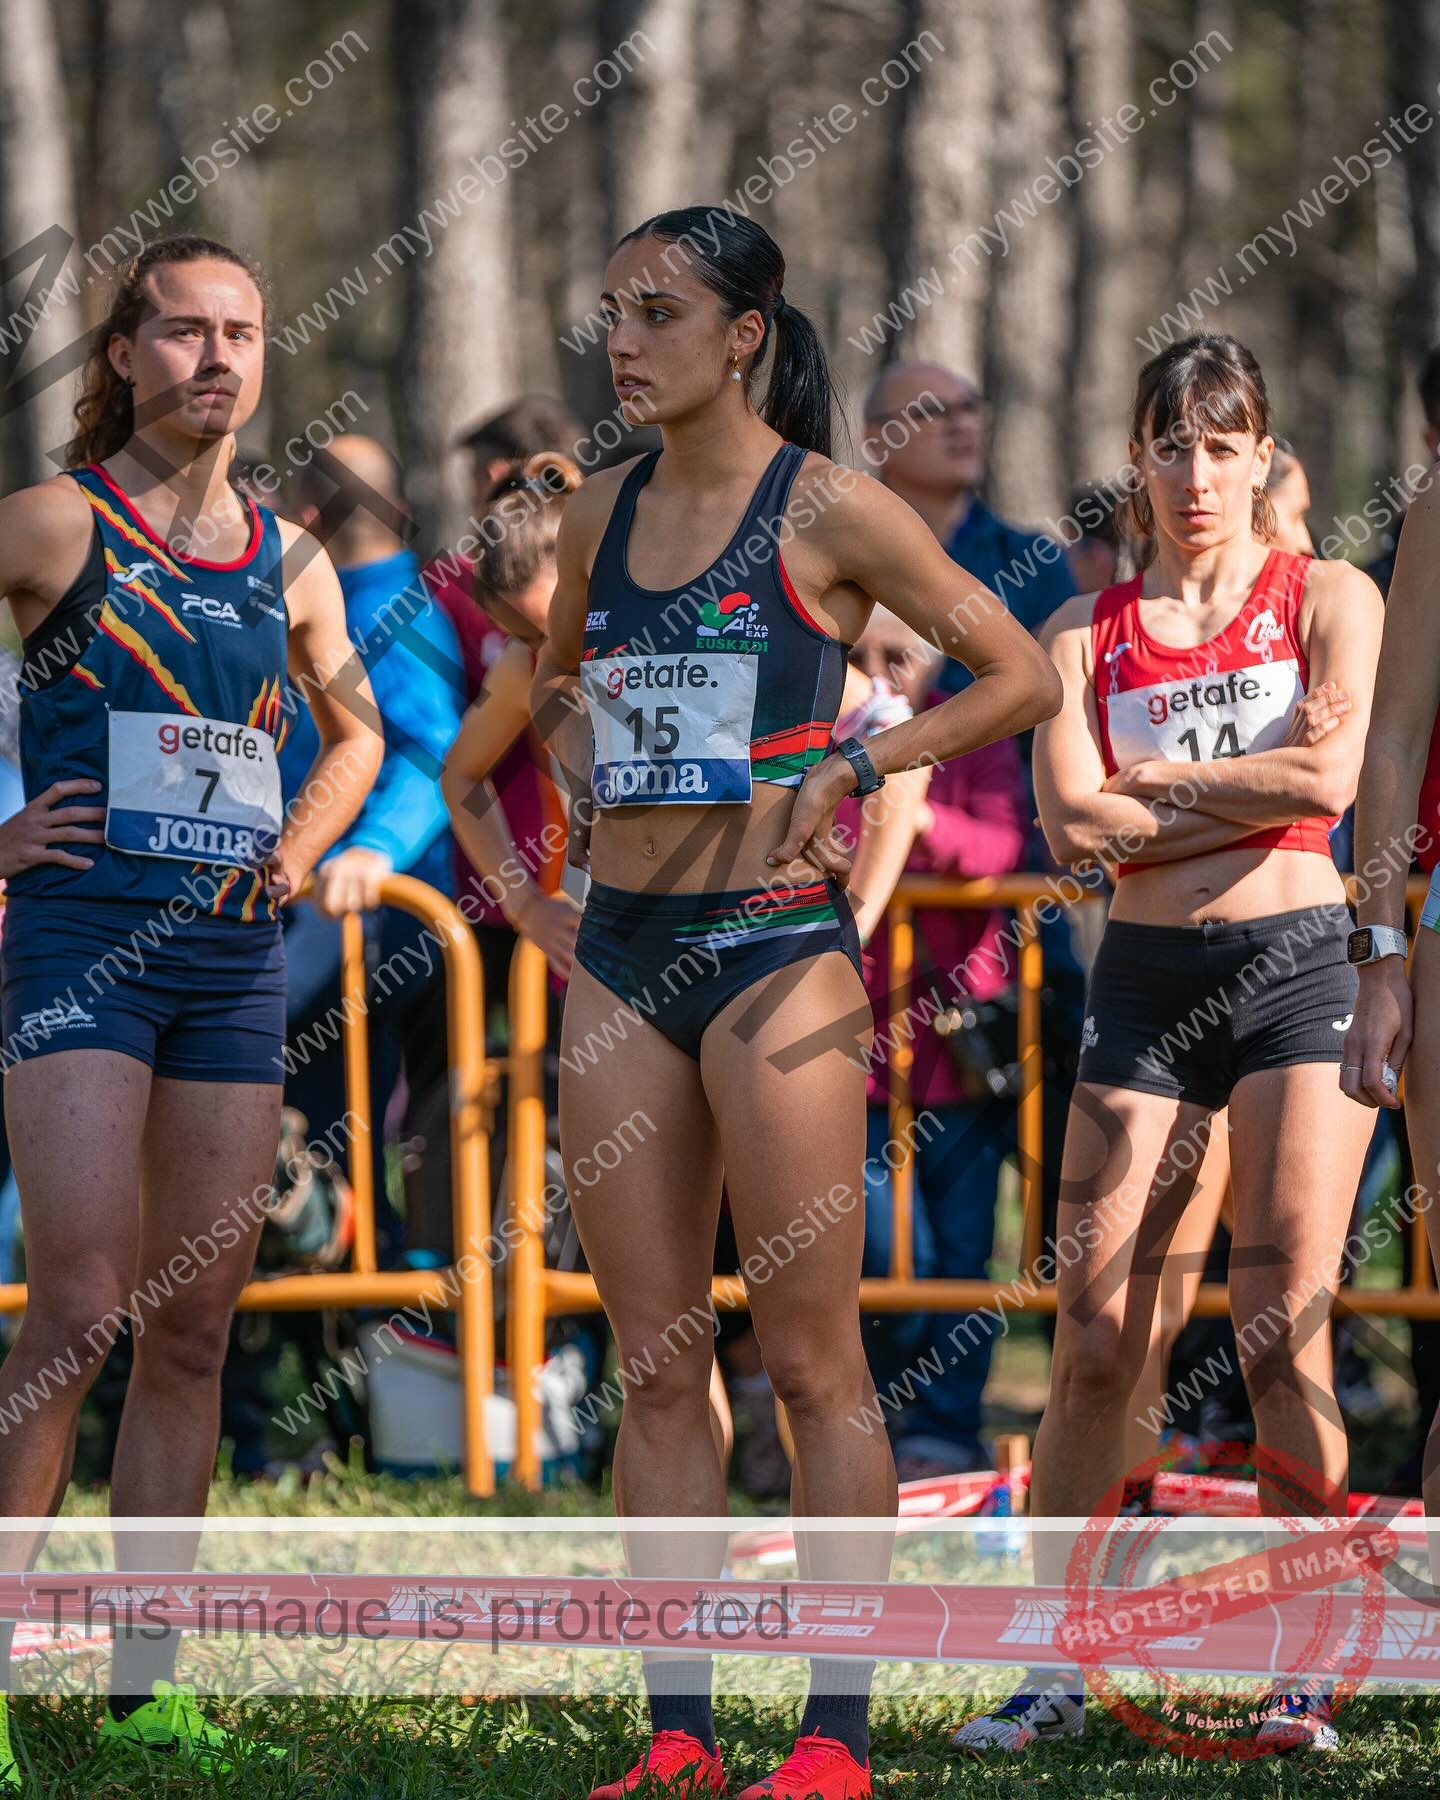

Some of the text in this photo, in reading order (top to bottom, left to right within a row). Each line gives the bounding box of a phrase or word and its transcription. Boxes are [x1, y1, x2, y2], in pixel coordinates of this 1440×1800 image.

[696, 637, 769, 653] EUSKADI
[746, 624, 769, 632] FVA
[606, 655, 719, 700] getafe.
[1148, 673, 1272, 726] getafe.
[158, 723, 263, 762] getafe.
[625, 706, 680, 755] 15
[1177, 721, 1247, 762] 14
[195, 768, 220, 814] 7
